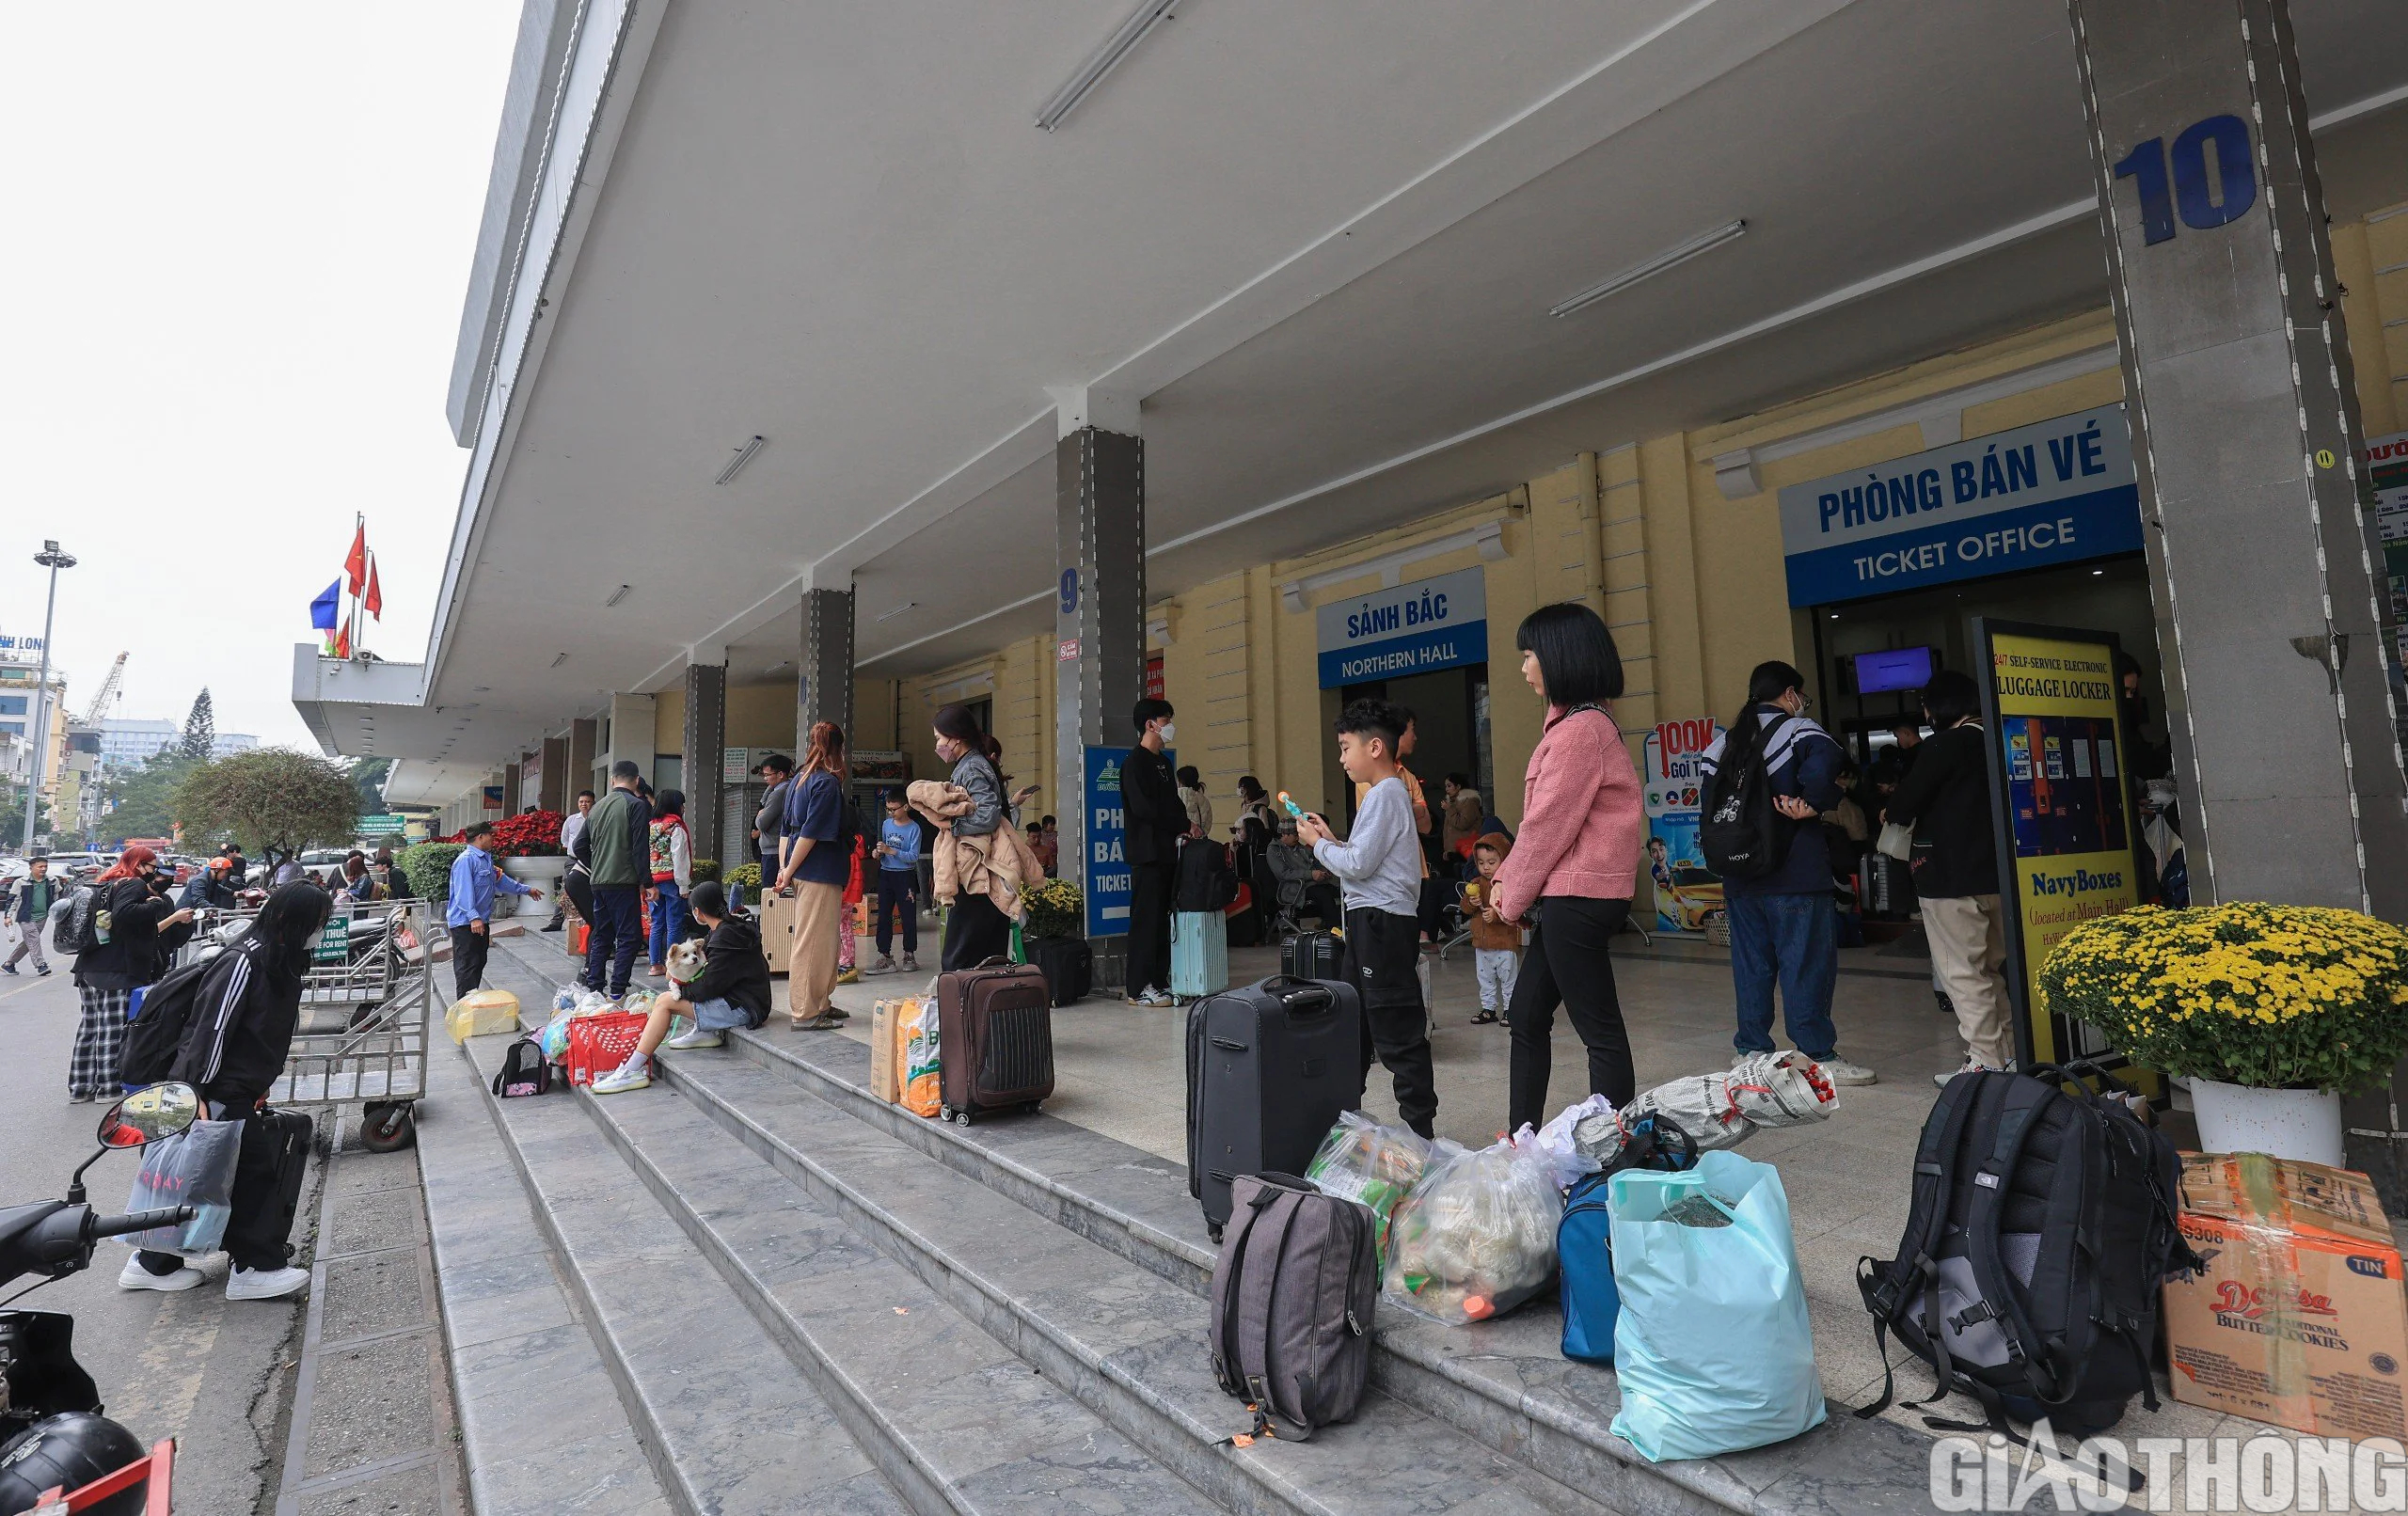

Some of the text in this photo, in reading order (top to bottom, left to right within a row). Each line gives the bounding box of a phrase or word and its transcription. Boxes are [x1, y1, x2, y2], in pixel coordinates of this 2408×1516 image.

[2114, 114, 2257, 246] 10
[1818, 419, 2106, 533] PHÒNG BÁN VÉ
[1853, 517, 2076, 580] TICKET OFFICE
[1061, 568, 1077, 613] 9
[1347, 588, 1448, 639] SẢNH BẮC
[1342, 642, 1457, 677] NORTHERN HALL
[2009, 655, 2062, 671] SELF-SERVICE
[2064, 659, 2108, 674] ELECTRONIC
[1998, 676, 2112, 700] LUGGAGE LOCKER
[1728, 852, 1751, 861] HOYA
[1095, 874, 1133, 892] TICKET
[2032, 869, 2122, 897] NavyBoxes
[2029, 906, 2066, 926] (located
[2067, 909, 2076, 922] at
[2076, 901, 2102, 921] Main
[325, 926, 347, 939] THUÊ
[2353, 1257, 2383, 1274] TIN
